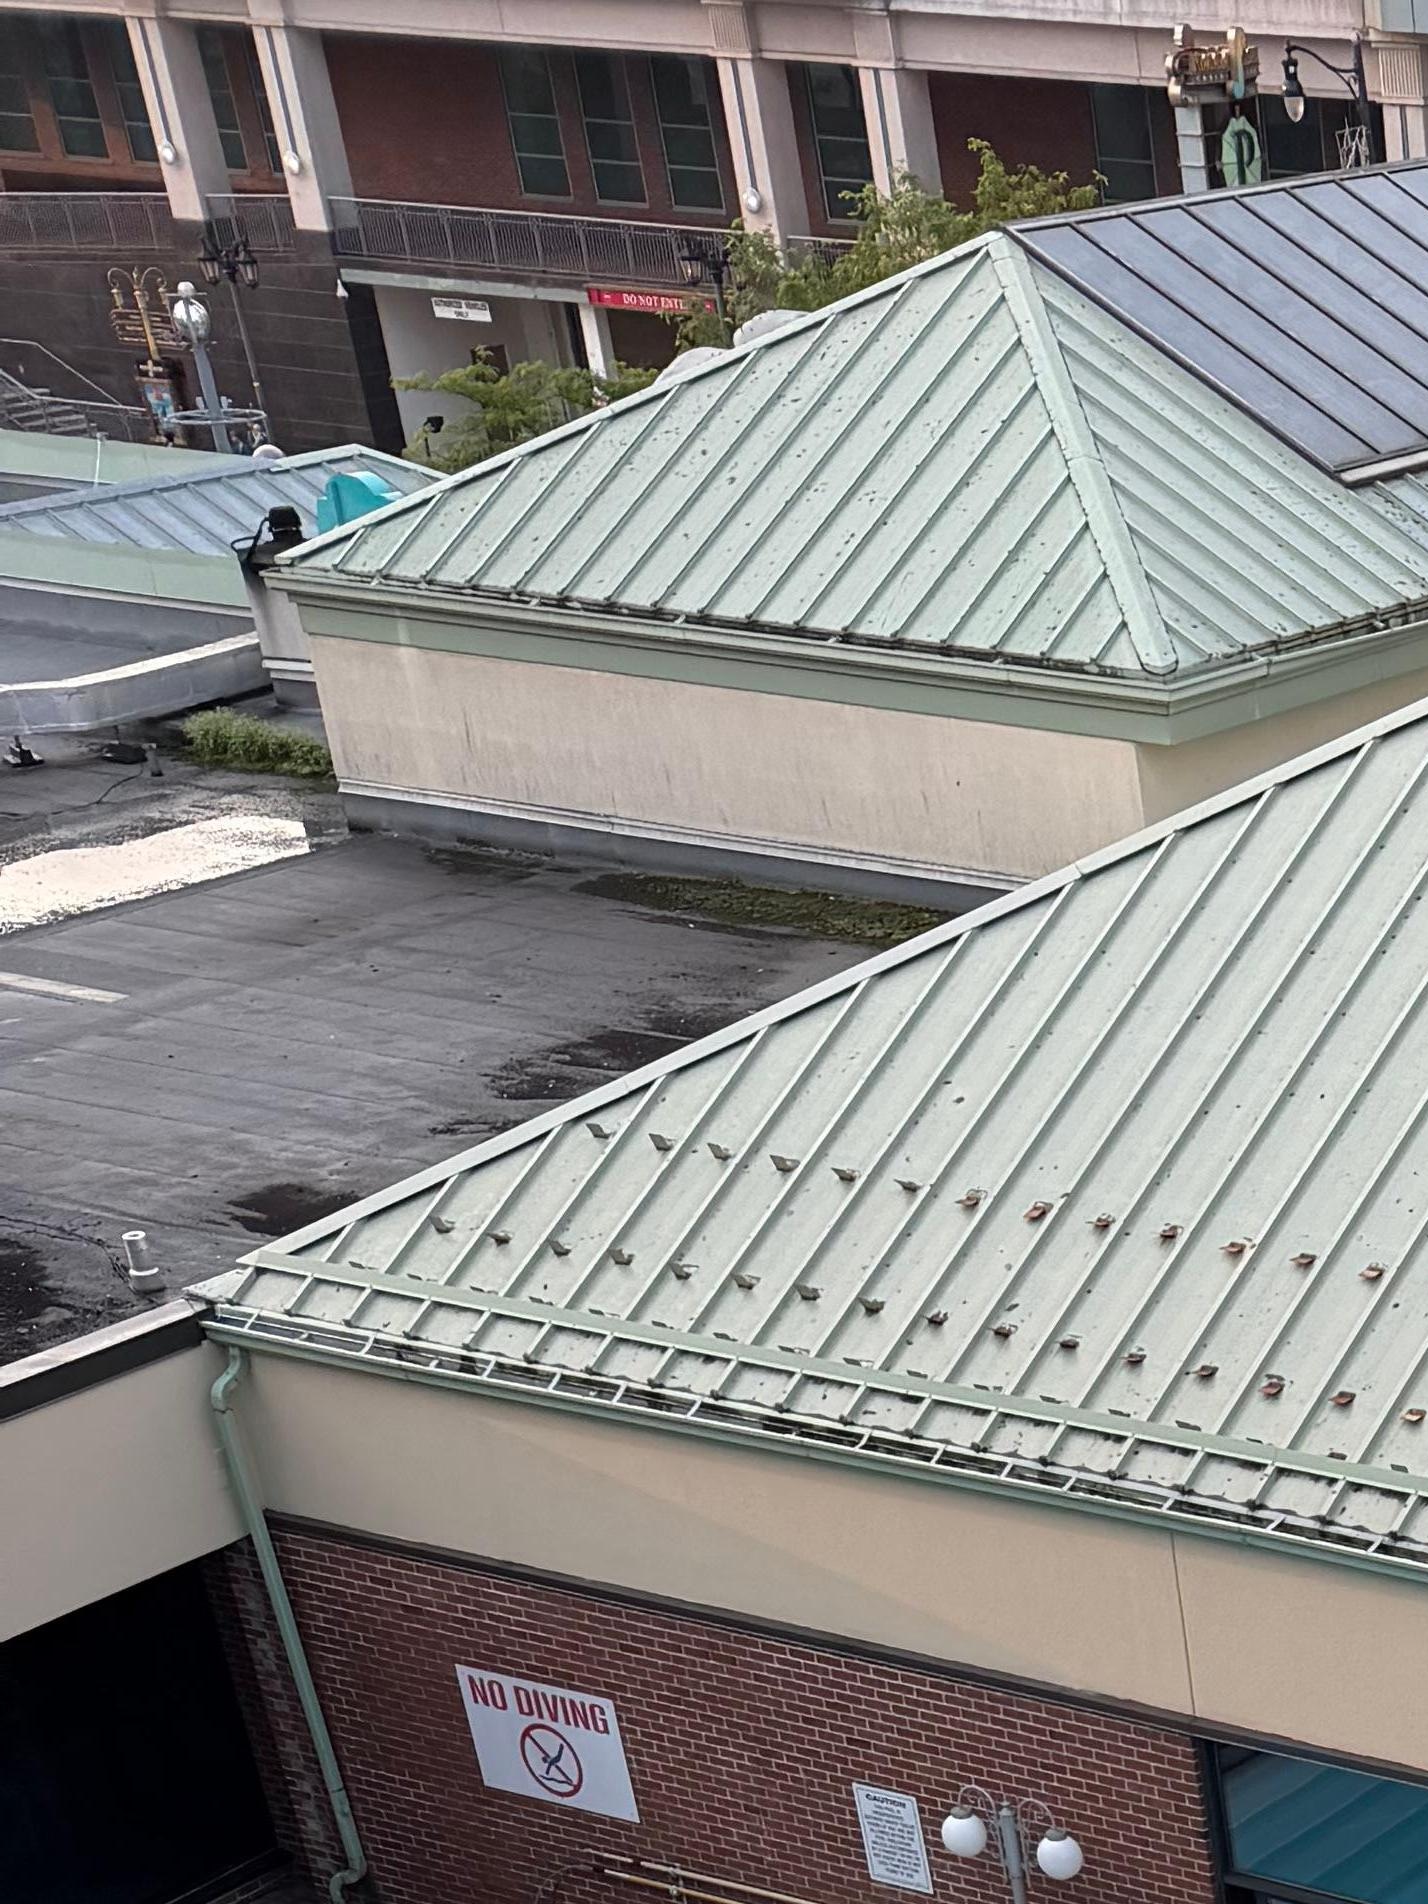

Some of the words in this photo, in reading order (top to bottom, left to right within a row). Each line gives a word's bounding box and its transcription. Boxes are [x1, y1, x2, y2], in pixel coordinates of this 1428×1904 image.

[622, 293, 636, 304] DO
[639, 295, 658, 307] NOT
[467, 1674, 508, 1711] NO
[513, 1685, 610, 1735] DIVING
[865, 1793, 907, 1809] CAUTION
